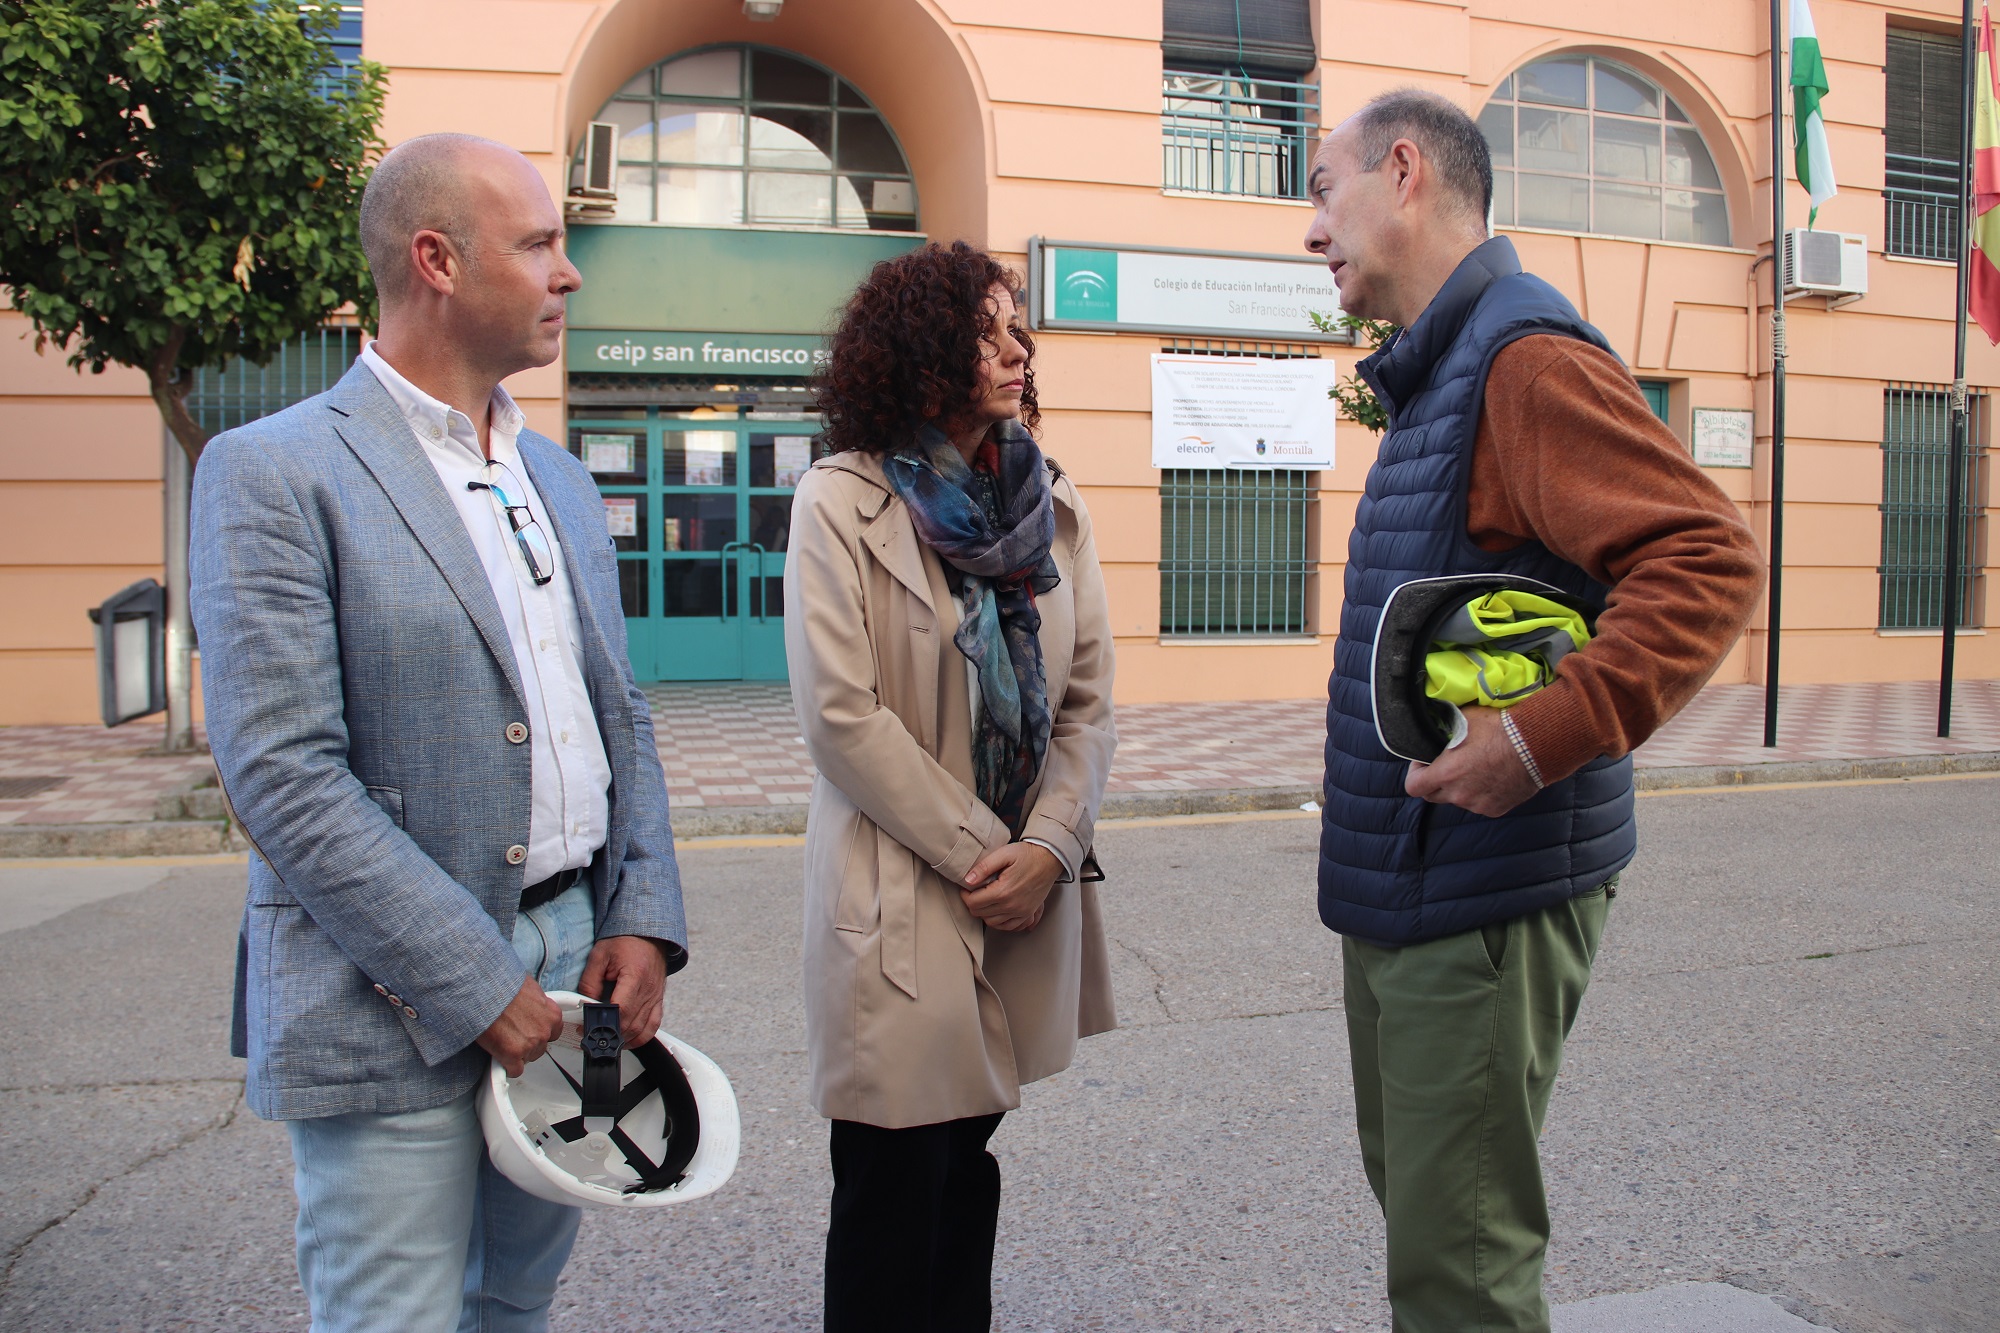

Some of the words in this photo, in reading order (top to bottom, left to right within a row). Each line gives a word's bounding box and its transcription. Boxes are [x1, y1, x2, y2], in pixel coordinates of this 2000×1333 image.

[1154, 278, 1188, 292] Colegio
[1191, 280, 1202, 290] de
[1206, 280, 1252, 292] Educación
[1254, 282, 1286, 293] Infantil
[1288, 286, 1293, 296] y
[1296, 284, 1333, 296] Primaria
[1228, 300, 1247, 314] San
[1251, 302, 1297, 318] Francisco
[597, 340, 646, 366] ceip
[652, 346, 694, 362] san
[702, 342, 808, 364] francisco
[1176, 443, 1215, 454] elecnor
[1273, 445, 1313, 455] Montilla
